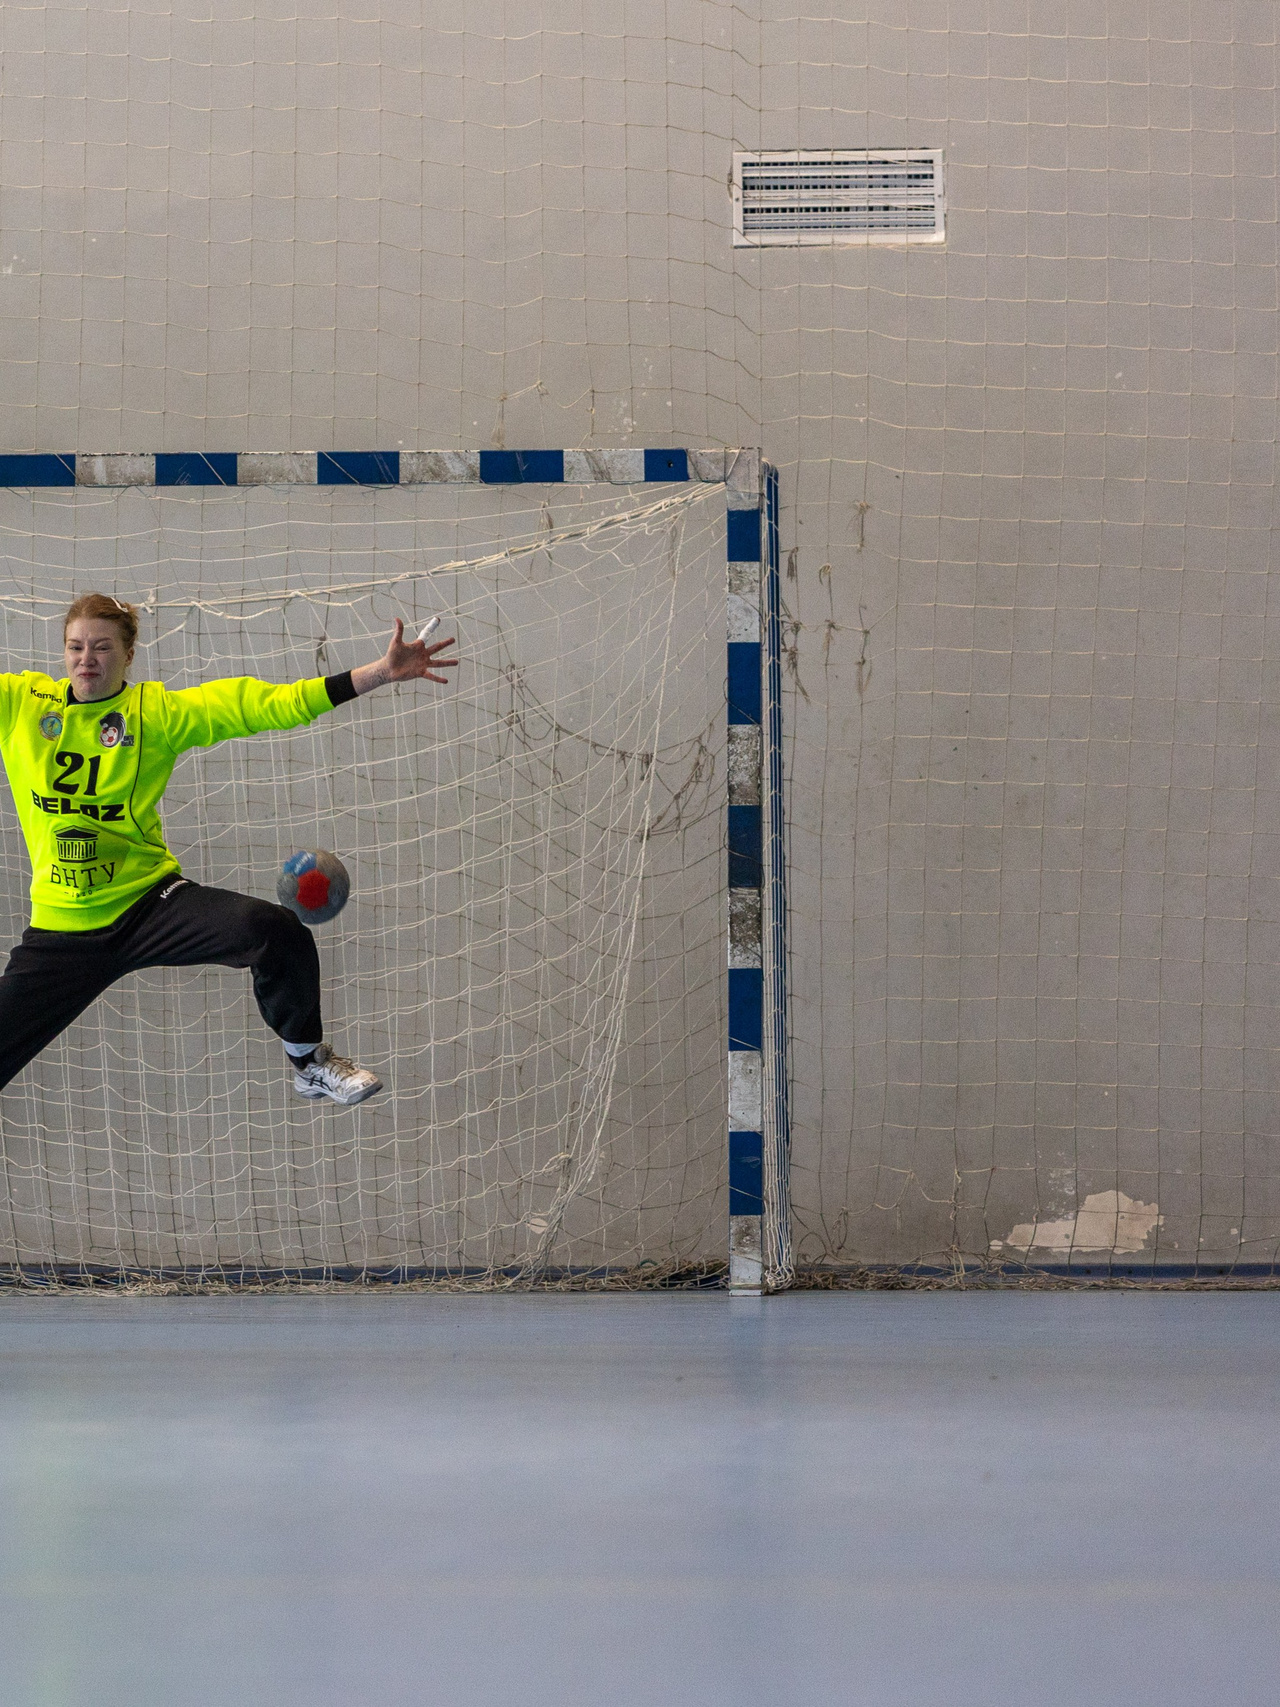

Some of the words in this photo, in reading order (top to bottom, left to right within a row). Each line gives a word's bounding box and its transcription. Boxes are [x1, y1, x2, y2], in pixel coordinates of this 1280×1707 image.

[52, 751, 101, 796] 21
[31, 789, 126, 822] BELAZ
[50, 862, 115, 888] БНТУ
